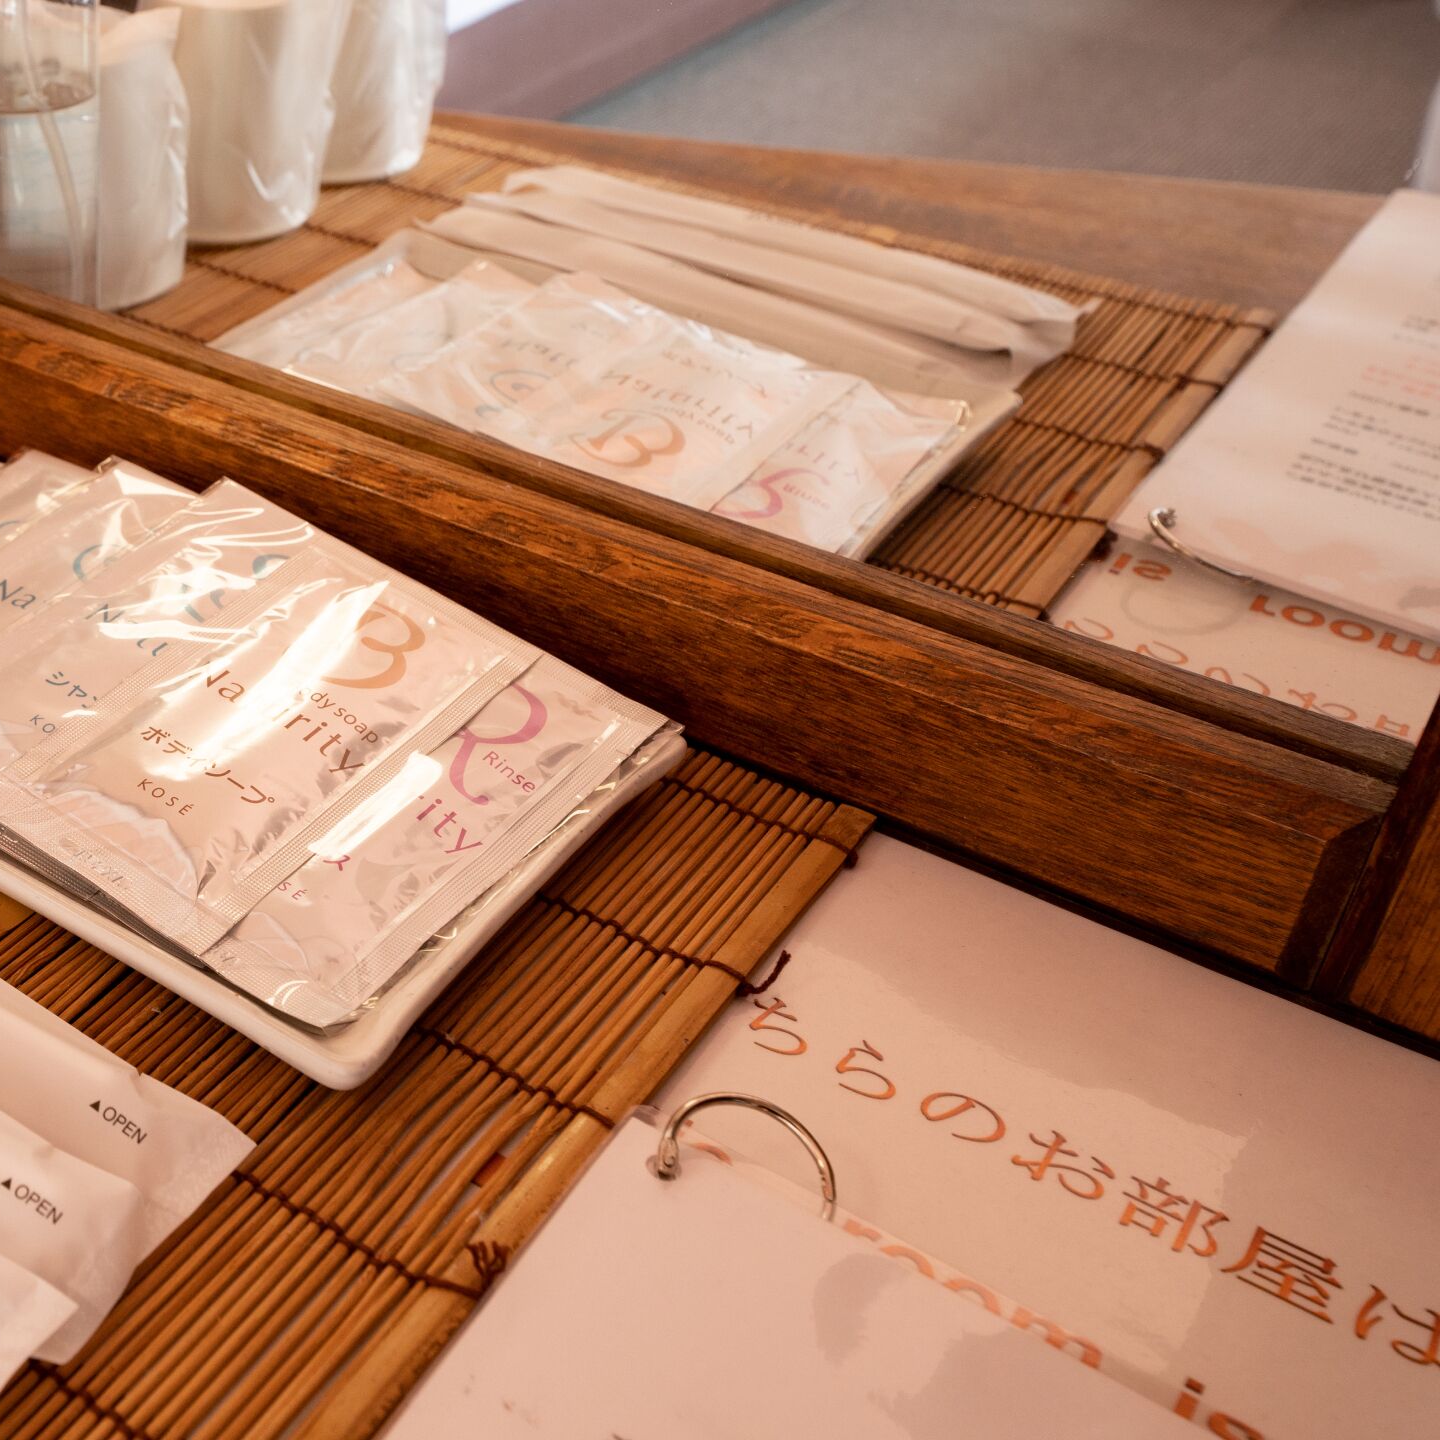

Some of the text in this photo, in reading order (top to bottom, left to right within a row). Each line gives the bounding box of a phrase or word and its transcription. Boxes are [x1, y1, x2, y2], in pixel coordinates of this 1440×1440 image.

[342, 706, 380, 745] soap
[482, 750, 537, 794] Rinse
[136, 776, 196, 817] KOSÉ
[101, 1105, 149, 1146] OPEN
[13, 1183, 65, 1226] OPEN
